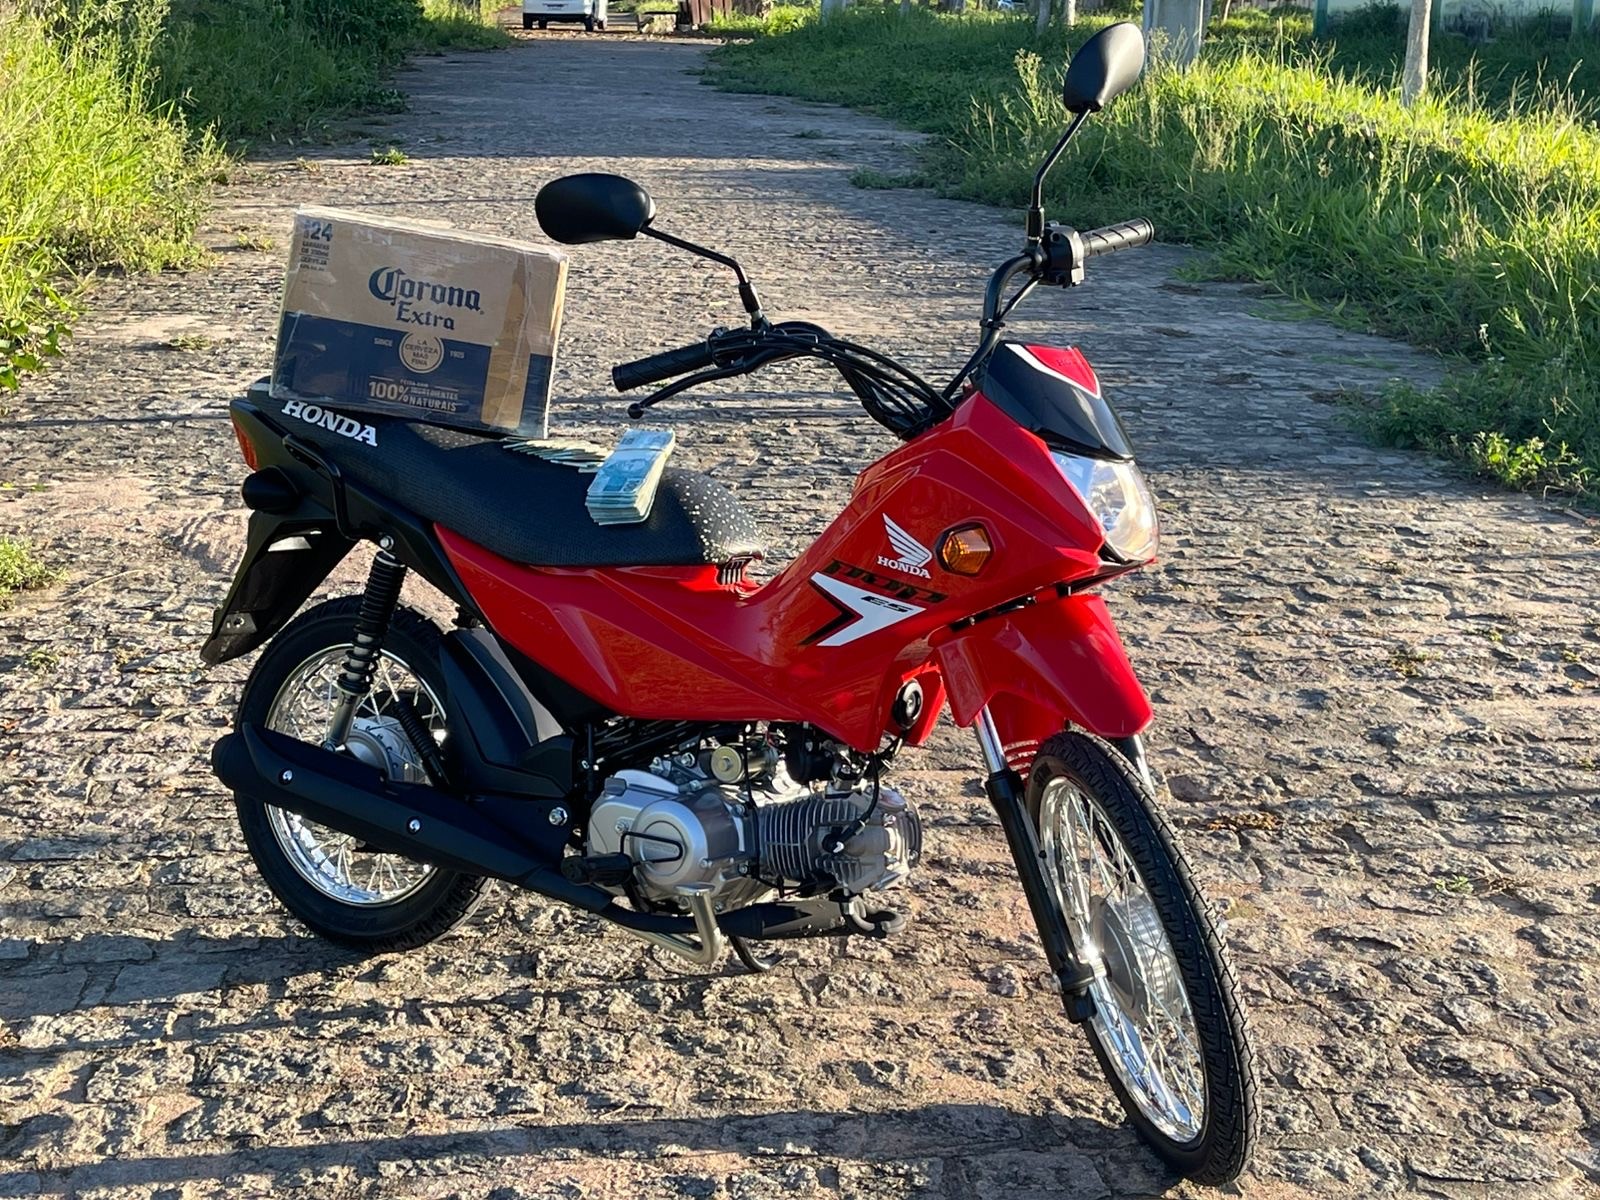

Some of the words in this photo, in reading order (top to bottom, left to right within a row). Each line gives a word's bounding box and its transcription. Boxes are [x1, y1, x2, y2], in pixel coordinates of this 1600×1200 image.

[310, 221, 333, 242] 24
[368, 266, 481, 312] Corona
[396, 300, 455, 331] Extra
[404, 343, 438, 355] CERVEZA
[411, 358, 428, 366] FINA
[369, 381, 409, 403] 100%
[409, 395, 457, 412] NATURAIS
[281, 399, 379, 447] HONDA
[877, 555, 931, 579] HONDA
